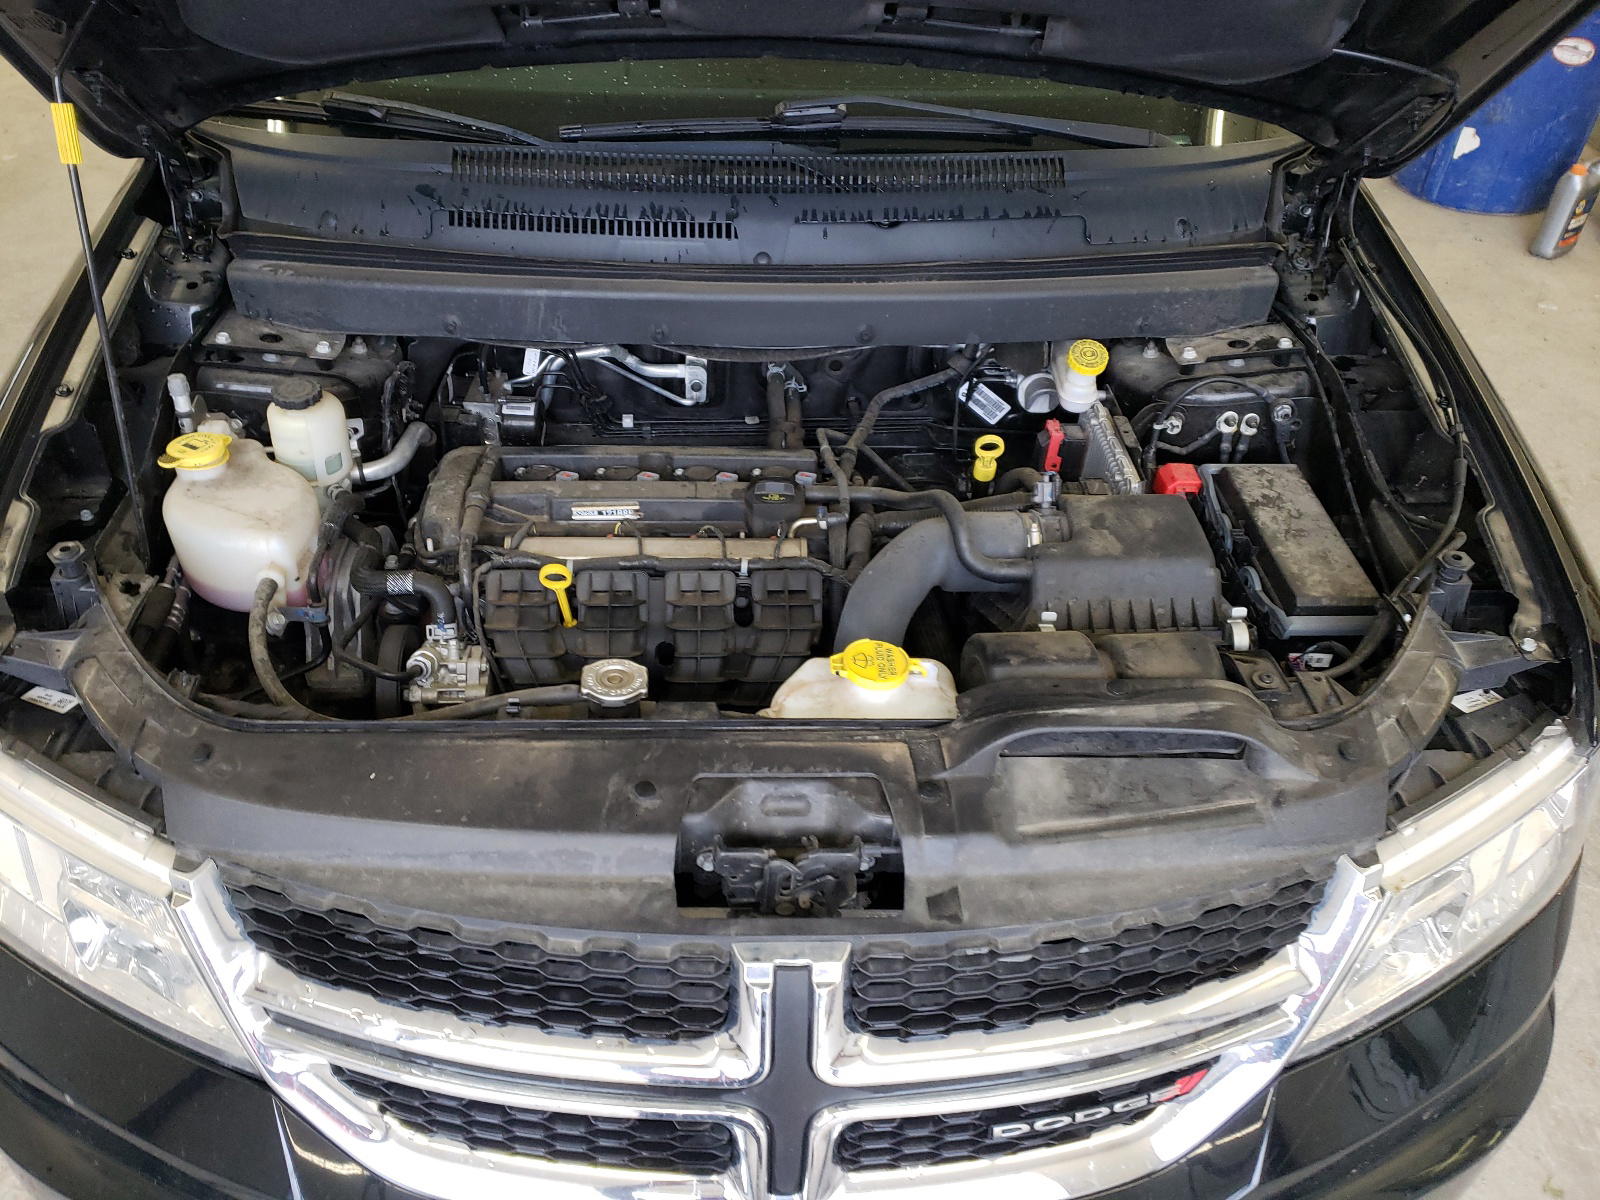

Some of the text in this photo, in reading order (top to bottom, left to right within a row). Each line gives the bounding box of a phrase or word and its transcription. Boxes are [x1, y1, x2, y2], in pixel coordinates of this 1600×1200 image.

[875, 642, 887, 679] FLUID ONLY
[886, 648, 897, 675] WASHER
[992, 1083, 1182, 1140] DODGE
